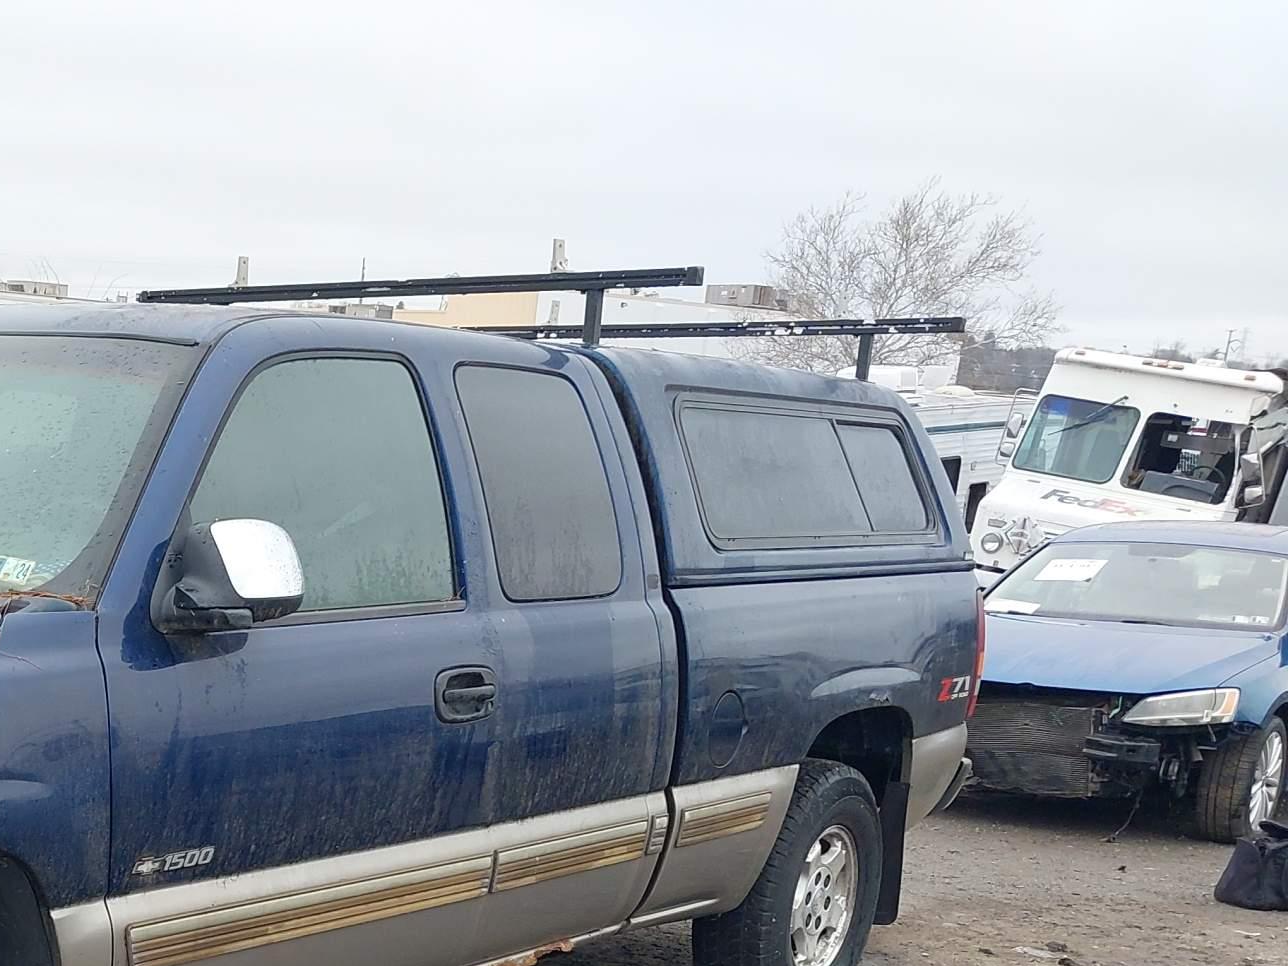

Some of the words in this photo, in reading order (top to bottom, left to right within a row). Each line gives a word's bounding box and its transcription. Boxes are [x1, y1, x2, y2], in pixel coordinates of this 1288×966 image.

[1040, 488, 1144, 517] FedEx
[937, 675, 971, 702] Z71
[162, 845, 216, 872] 1500
